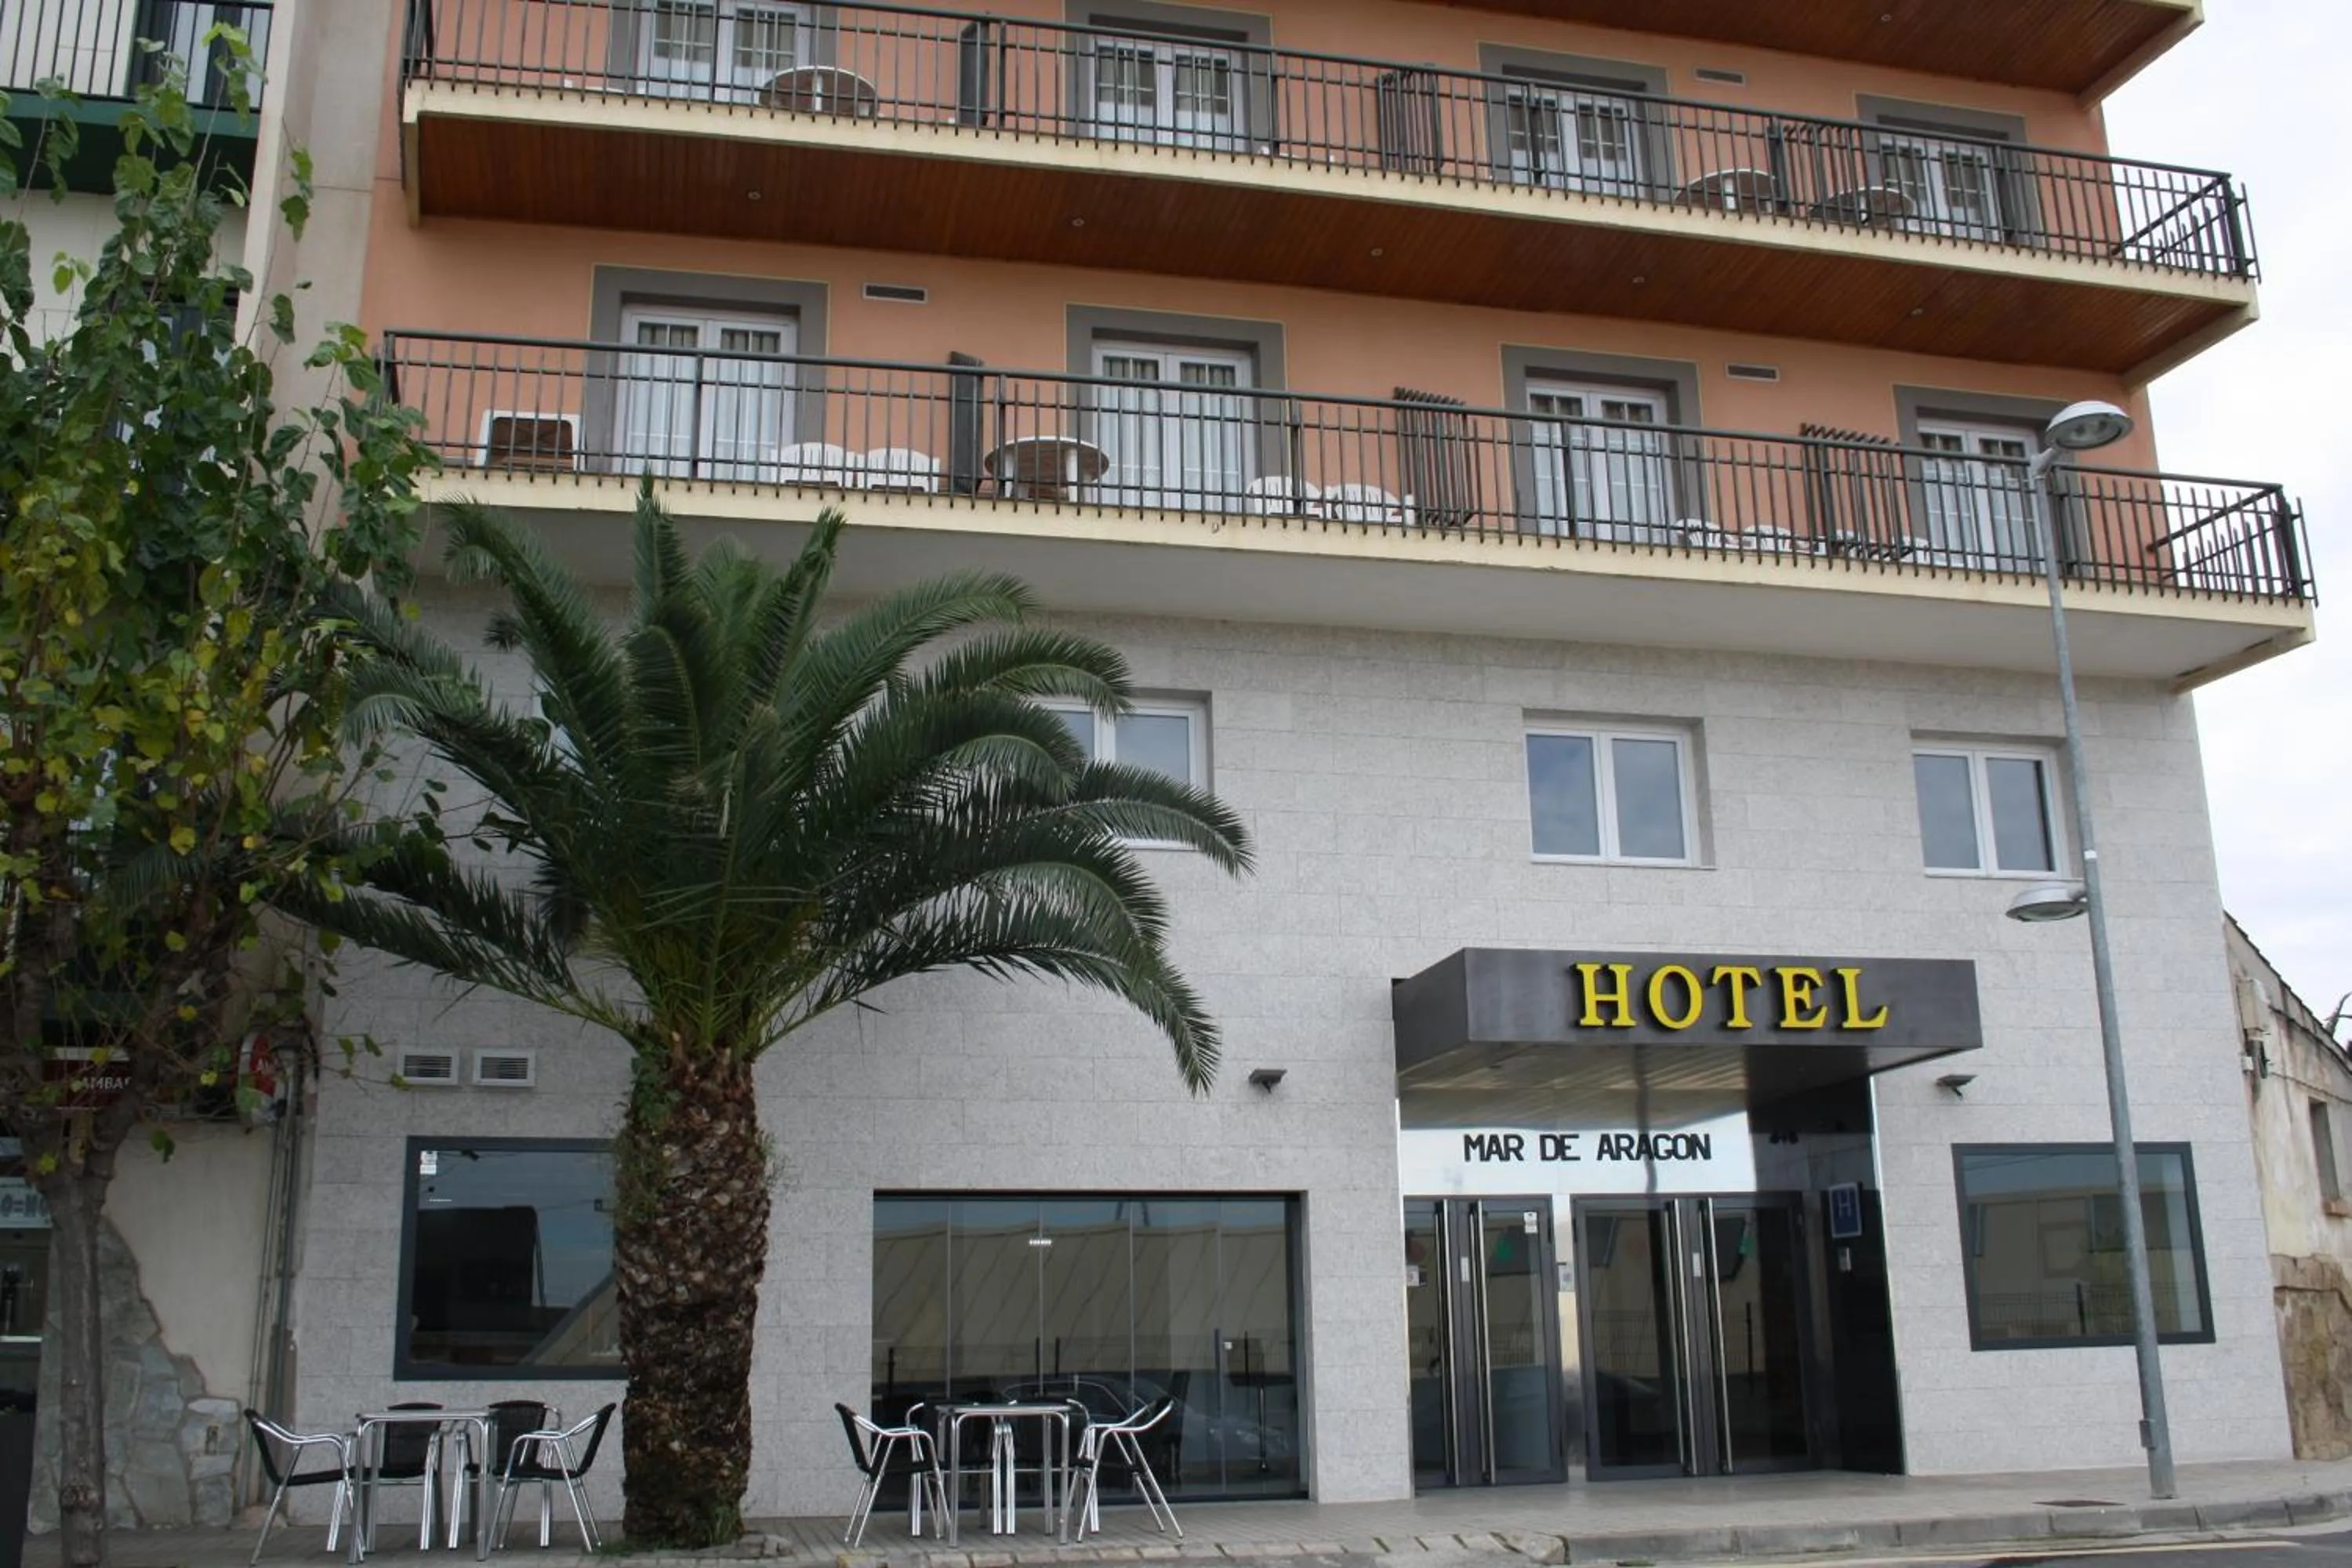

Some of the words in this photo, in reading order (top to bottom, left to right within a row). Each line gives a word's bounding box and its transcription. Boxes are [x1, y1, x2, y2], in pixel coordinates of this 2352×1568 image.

[1576, 963, 1888, 1029] HOTEL
[1463, 1133, 1525, 1162] MAR
[1539, 1133, 1581, 1161] DE
[1595, 1133, 1711, 1161] ARAGON
